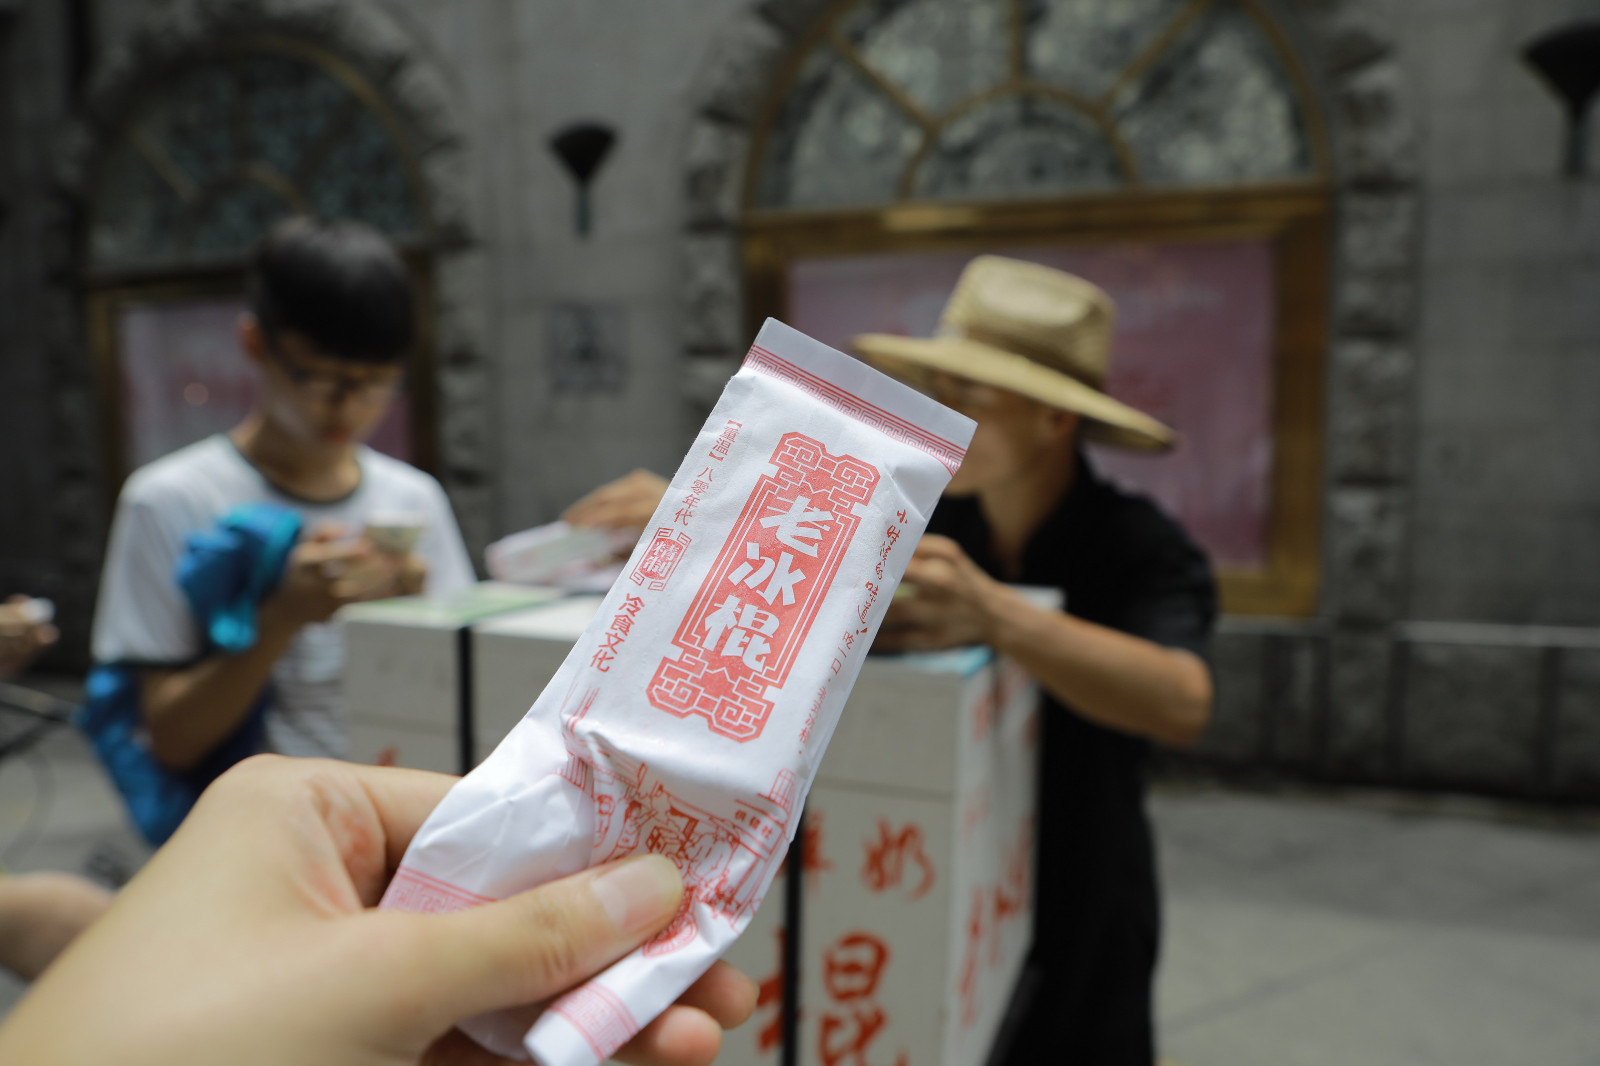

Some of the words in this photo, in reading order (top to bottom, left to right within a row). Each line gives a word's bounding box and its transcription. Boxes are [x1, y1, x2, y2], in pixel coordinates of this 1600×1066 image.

[673, 467, 717, 526] 八零年代
[642, 541, 680, 579] 精制
[702, 495, 835, 672] 老冰棍
[590, 593, 645, 672] 冷食文化
